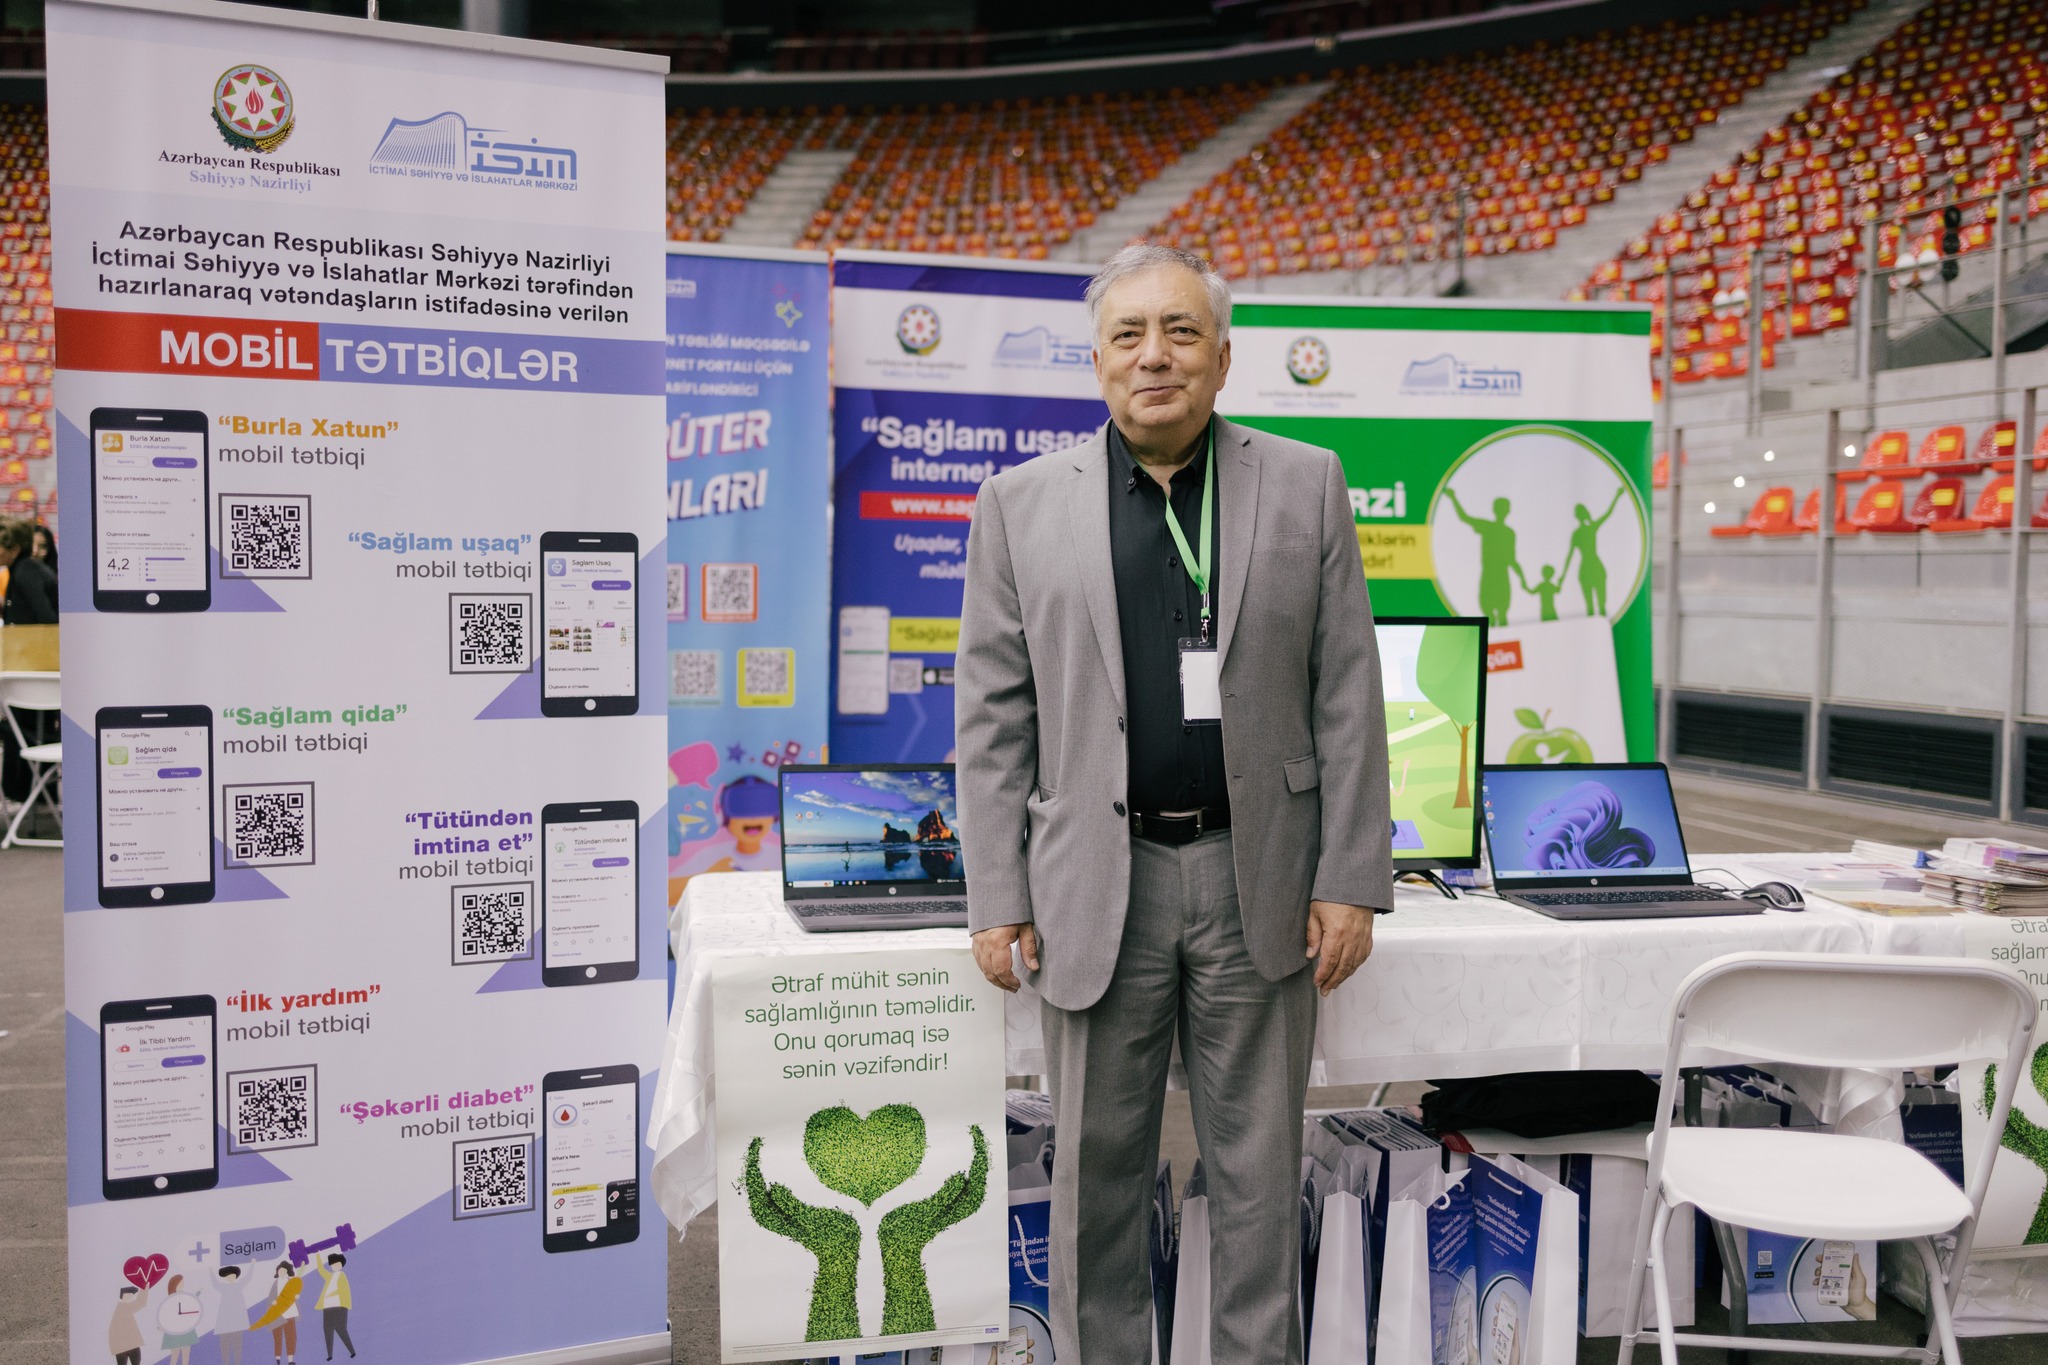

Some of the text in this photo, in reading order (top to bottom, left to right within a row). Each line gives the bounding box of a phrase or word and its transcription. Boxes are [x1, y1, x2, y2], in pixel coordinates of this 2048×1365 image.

[158, 150, 340, 176] Azərbaycan Respublikası
[190, 170, 311, 193] Səhiyyə Nazirliyi
[369, 163, 578, 191] İCTİMAİ SƏHİYYƏ VƏ İSLAHATLAR MƏRKƏZİ
[119, 219, 611, 276] Azərbaycan Respublikası Səhiyyə Nazirliyi
[91, 241, 177, 270] İctimai
[183, 251, 281, 280] Səhiyyə
[287, 261, 316, 279] və
[321, 255, 429, 287] İslahatlar
[435, 268, 520, 293] Mərkəzi
[526, 274, 634, 300] tərəfindən
[98, 274, 629, 324] hazırlanaraq vətəndaşların istifadəsinə verilən
[160, 327, 579, 384] MOBİL TƏTBİQLƏR
[218, 415, 399, 442] “Burla Xatun”
[666, 410, 772, 462] ÜTER
[219, 445, 367, 470] mobil tətbiqi
[891, 455, 995, 484] internet
[1347, 481, 1406, 518] RZİ
[348, 531, 532, 556] “Sağlam uşaq”
[107, 558, 130, 571] 4,2
[396, 561, 532, 582] mobil tətbiqi
[223, 704, 407, 728] “Sağlam qida”
[135, 746, 160, 754] Sağlam
[223, 732, 368, 754] mobil tətbiqi
[405, 809, 533, 830] “Tütündən
[414, 832, 533, 856] imtina et”
[399, 856, 533, 879] mobil tətbiqi
[2011, 918, 2048, 933] Ətra
[771, 968, 950, 994] Ətraf mühit sənin
[226, 984, 380, 1012] “İlk yardım”
[744, 994, 976, 1026] sağlamlığının təməlidir.
[226, 1012, 370, 1042] mobil tətbiqi
[774, 1026, 950, 1052] Onu qorumaq isə
[782, 1052, 948, 1079] sənin vəzifəndir!
[340, 1084, 534, 1124] “Şəkərli diabet”
[401, 1108, 534, 1138] mobil tətbiqi
[224, 1239, 276, 1256] Sağlam
